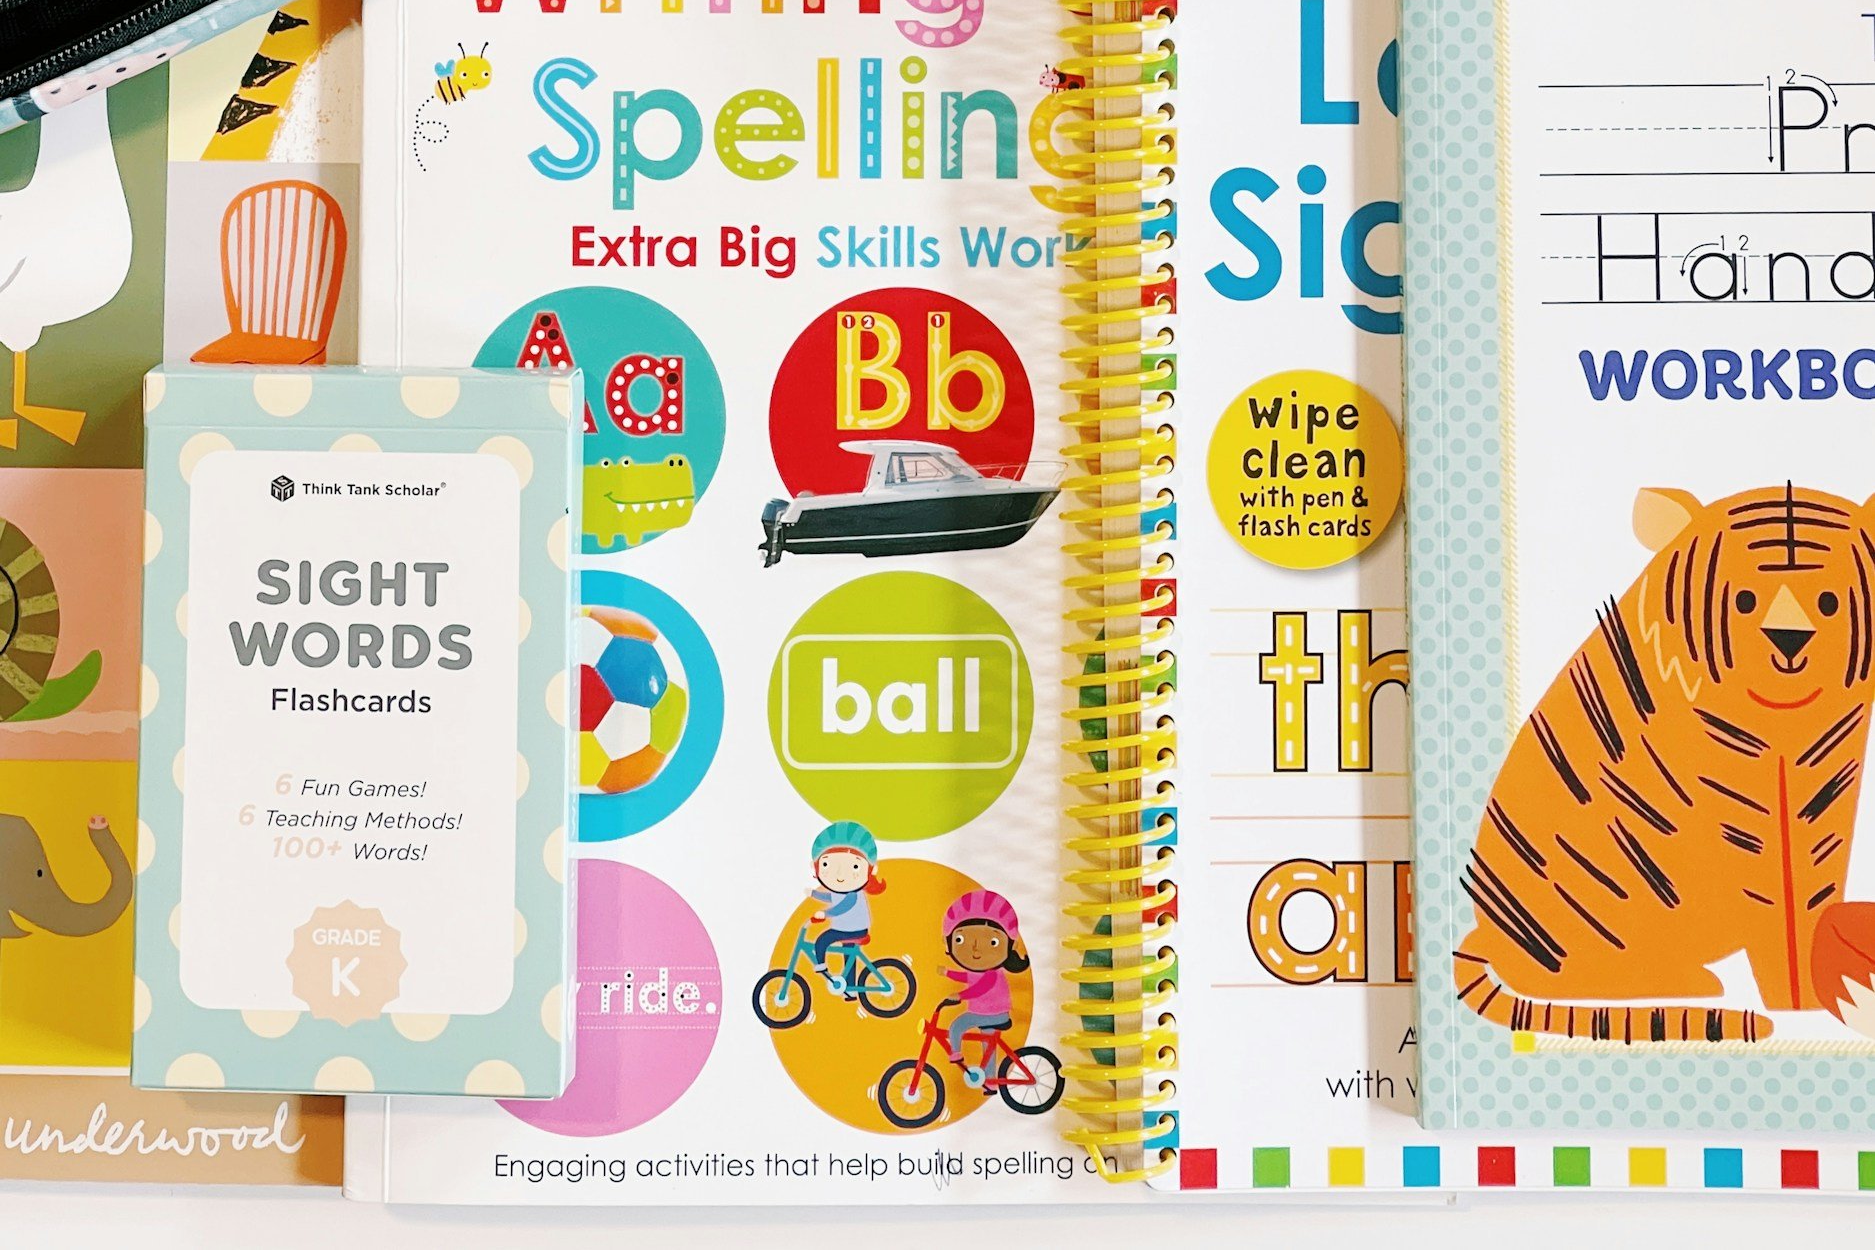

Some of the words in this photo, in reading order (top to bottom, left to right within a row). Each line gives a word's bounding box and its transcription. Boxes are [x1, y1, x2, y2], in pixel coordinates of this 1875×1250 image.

[572, 225, 698, 269] Extra
[720, 225, 797, 278] Big
[817, 225, 941, 269] Skills
[1248, 390, 1360, 444] Wipe
[1243, 439, 1366, 479] clean
[302, 483, 342, 495] Think
[347, 484, 380, 496] Tank
[1240, 485, 1294, 508] with
[1302, 491, 1344, 515] pen
[1351, 485, 1369, 507] &
[1238, 513, 1300, 536] flash
[1308, 514, 1372, 537] cards
[256, 559, 450, 608] SIGHT
[228, 621, 474, 671] WORDS
[270, 686, 433, 716] Flashcards
[822, 657, 981, 734] ball
[275, 773, 293, 795] 6
[301, 779, 340, 797] Fun
[348, 780, 427, 798] Games!
[238, 804, 257, 827] 6
[266, 809, 358, 831] Teaching
[364, 811, 463, 830] Methods!
[273, 836, 342, 860] 100+
[353, 842, 428, 861] Words!
[312, 928, 382, 946] GRADE
[331, 956, 361, 998] K
[600, 967, 717, 1014] ride.
[1325, 1069, 1394, 1098] with
[4, 1101, 307, 1156] underwood
[494, 1153, 626, 1182] Engaging
[635, 1153, 755, 1177] activities
[764, 1152, 819, 1177] that
[828, 1152, 888, 1182] help
[898, 1151, 963, 1176] build
[973, 1151, 1074, 1180] spelling
